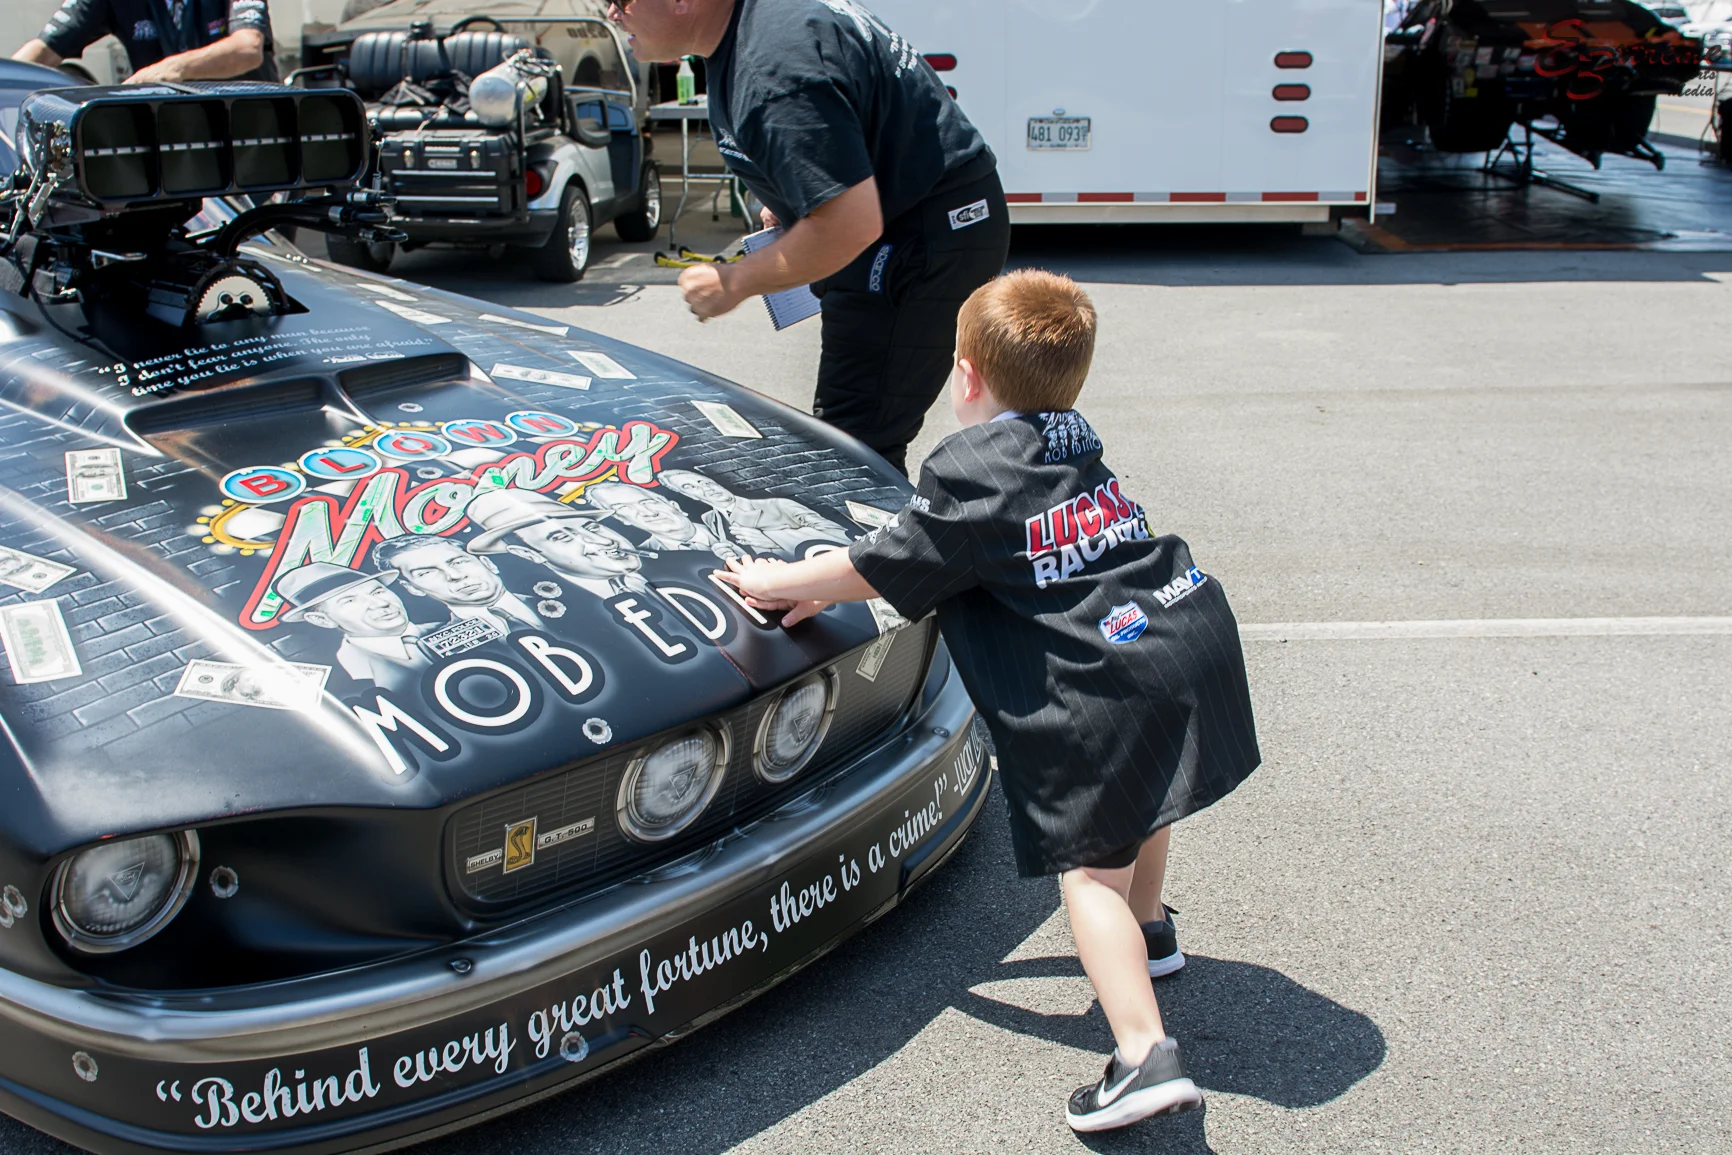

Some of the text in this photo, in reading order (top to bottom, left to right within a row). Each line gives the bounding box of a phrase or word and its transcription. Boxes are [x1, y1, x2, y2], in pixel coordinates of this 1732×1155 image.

[1031, 126, 1051, 142] 481
[1059, 126, 1080, 142] 093
[870, 245, 890, 291] sparco
[117, 333, 372, 386] I don't fear anyone. The only
[131, 379, 175, 397] time
[177, 370, 214, 386] you
[215, 362, 240, 373] lie
[241, 358, 258, 367] is
[263, 349, 308, 362] when
[310, 344, 345, 355] you
[346, 342, 373, 350] are
[133, 353, 182, 369] never
[184, 347, 209, 357] lie
[210, 343, 230, 351] to
[233, 336, 268, 346] any
[271, 331, 306, 339] man
[309, 326, 371, 335] because
[241, 416, 565, 498] BLOWN
[243, 421, 680, 629] Money
[1026, 477, 1133, 560] LUCAS
[1033, 517, 1149, 589] RACING
[1152, 567, 1203, 605] MAVT
[1110, 609, 1137, 635] LUCAS
[353, 636, 594, 776] MOB
[568, 823, 588, 835] 500
[470, 853, 499, 869] SHELBY
[394, 1022, 516, 1087] every
[528, 968, 631, 1058] great
[640, 919, 768, 1014] fortune,
[770, 880, 837, 933] there
[839, 854, 860, 891] is
[868, 842, 886, 873] a
